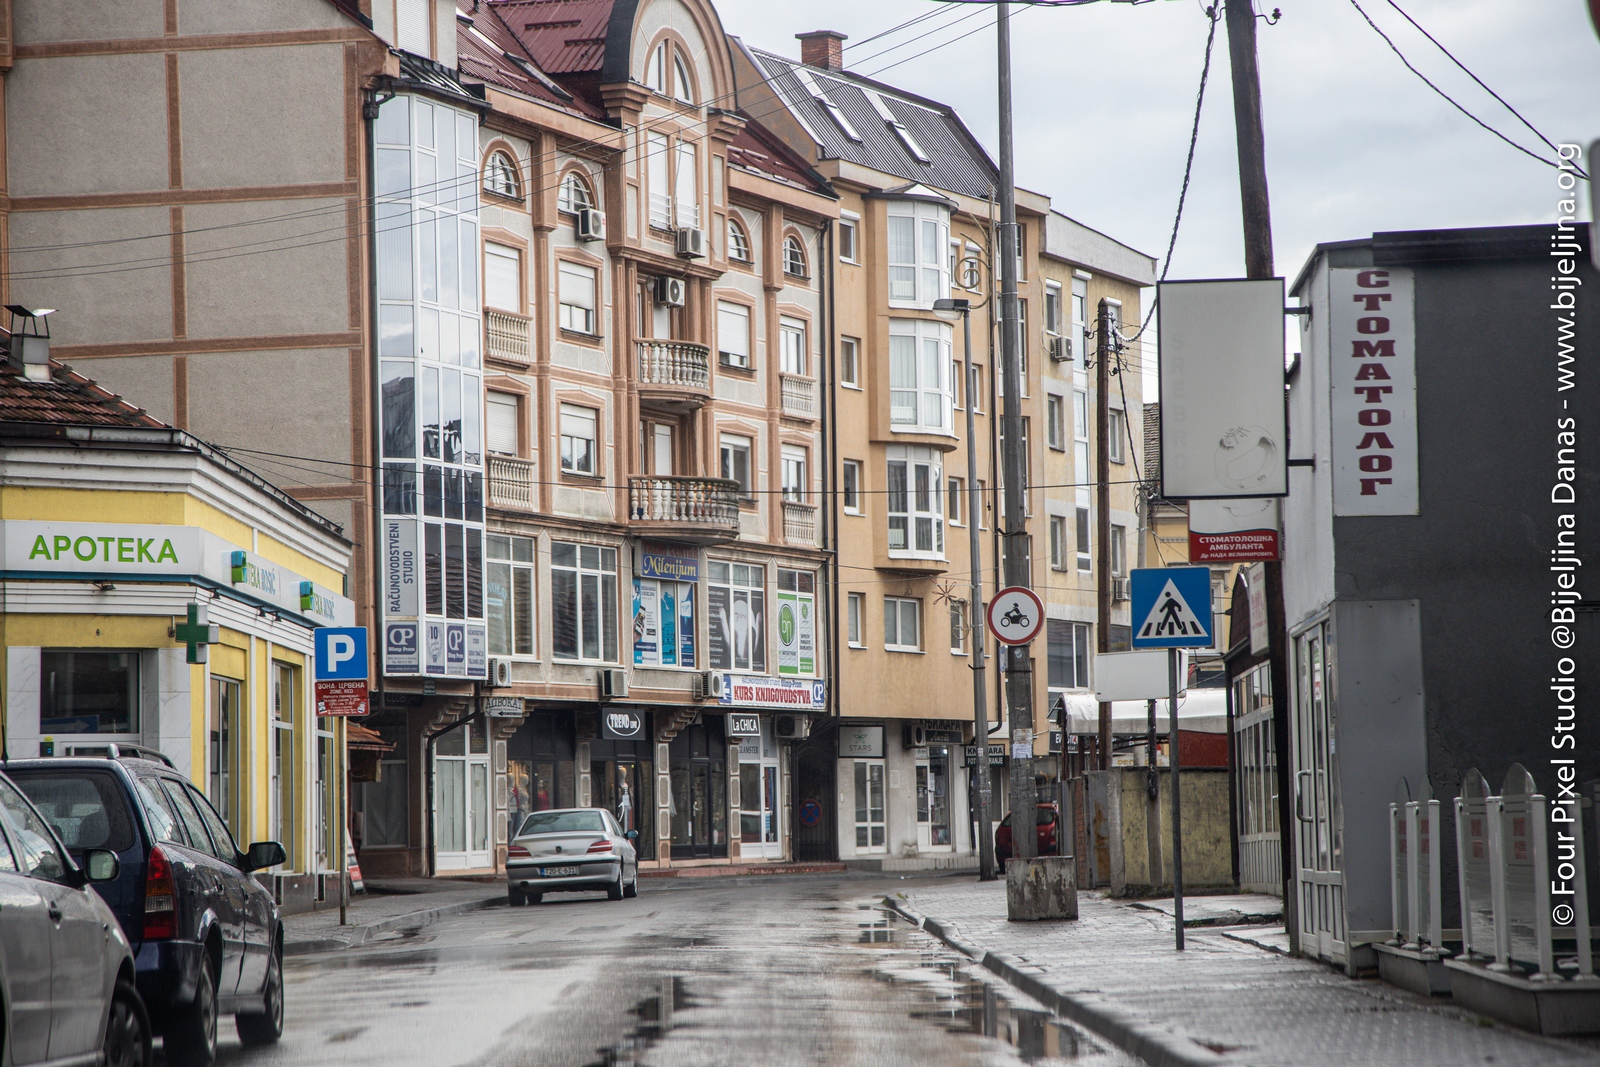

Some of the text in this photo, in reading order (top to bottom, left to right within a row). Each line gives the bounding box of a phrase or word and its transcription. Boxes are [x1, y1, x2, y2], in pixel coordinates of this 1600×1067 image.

[1351, 270, 1396, 496] СТОМАТОЛОГ
[1199, 534, 1274, 544] СТОМАТОЛОШКА
[1209, 543, 1265, 551] АМБУЛАНТА
[28, 534, 179, 564] APOTEKA
[387, 522, 401, 613] RAČUNOVODSTVENI
[403, 550, 414, 584] STUDIO
[643, 555, 697, 580] Milenijum
[430, 626, 438, 640] 10
[327, 634, 355, 673] P
[338, 682, 365, 690] ЦРВЕНА
[733, 685, 811, 704] KURS KNJIGOVODSTVA
[485, 697, 522, 710] АДВОКАТ
[610, 713, 630, 729] TREND
[732, 718, 758, 731] La CHICA
[848, 744, 873, 752] STARS
